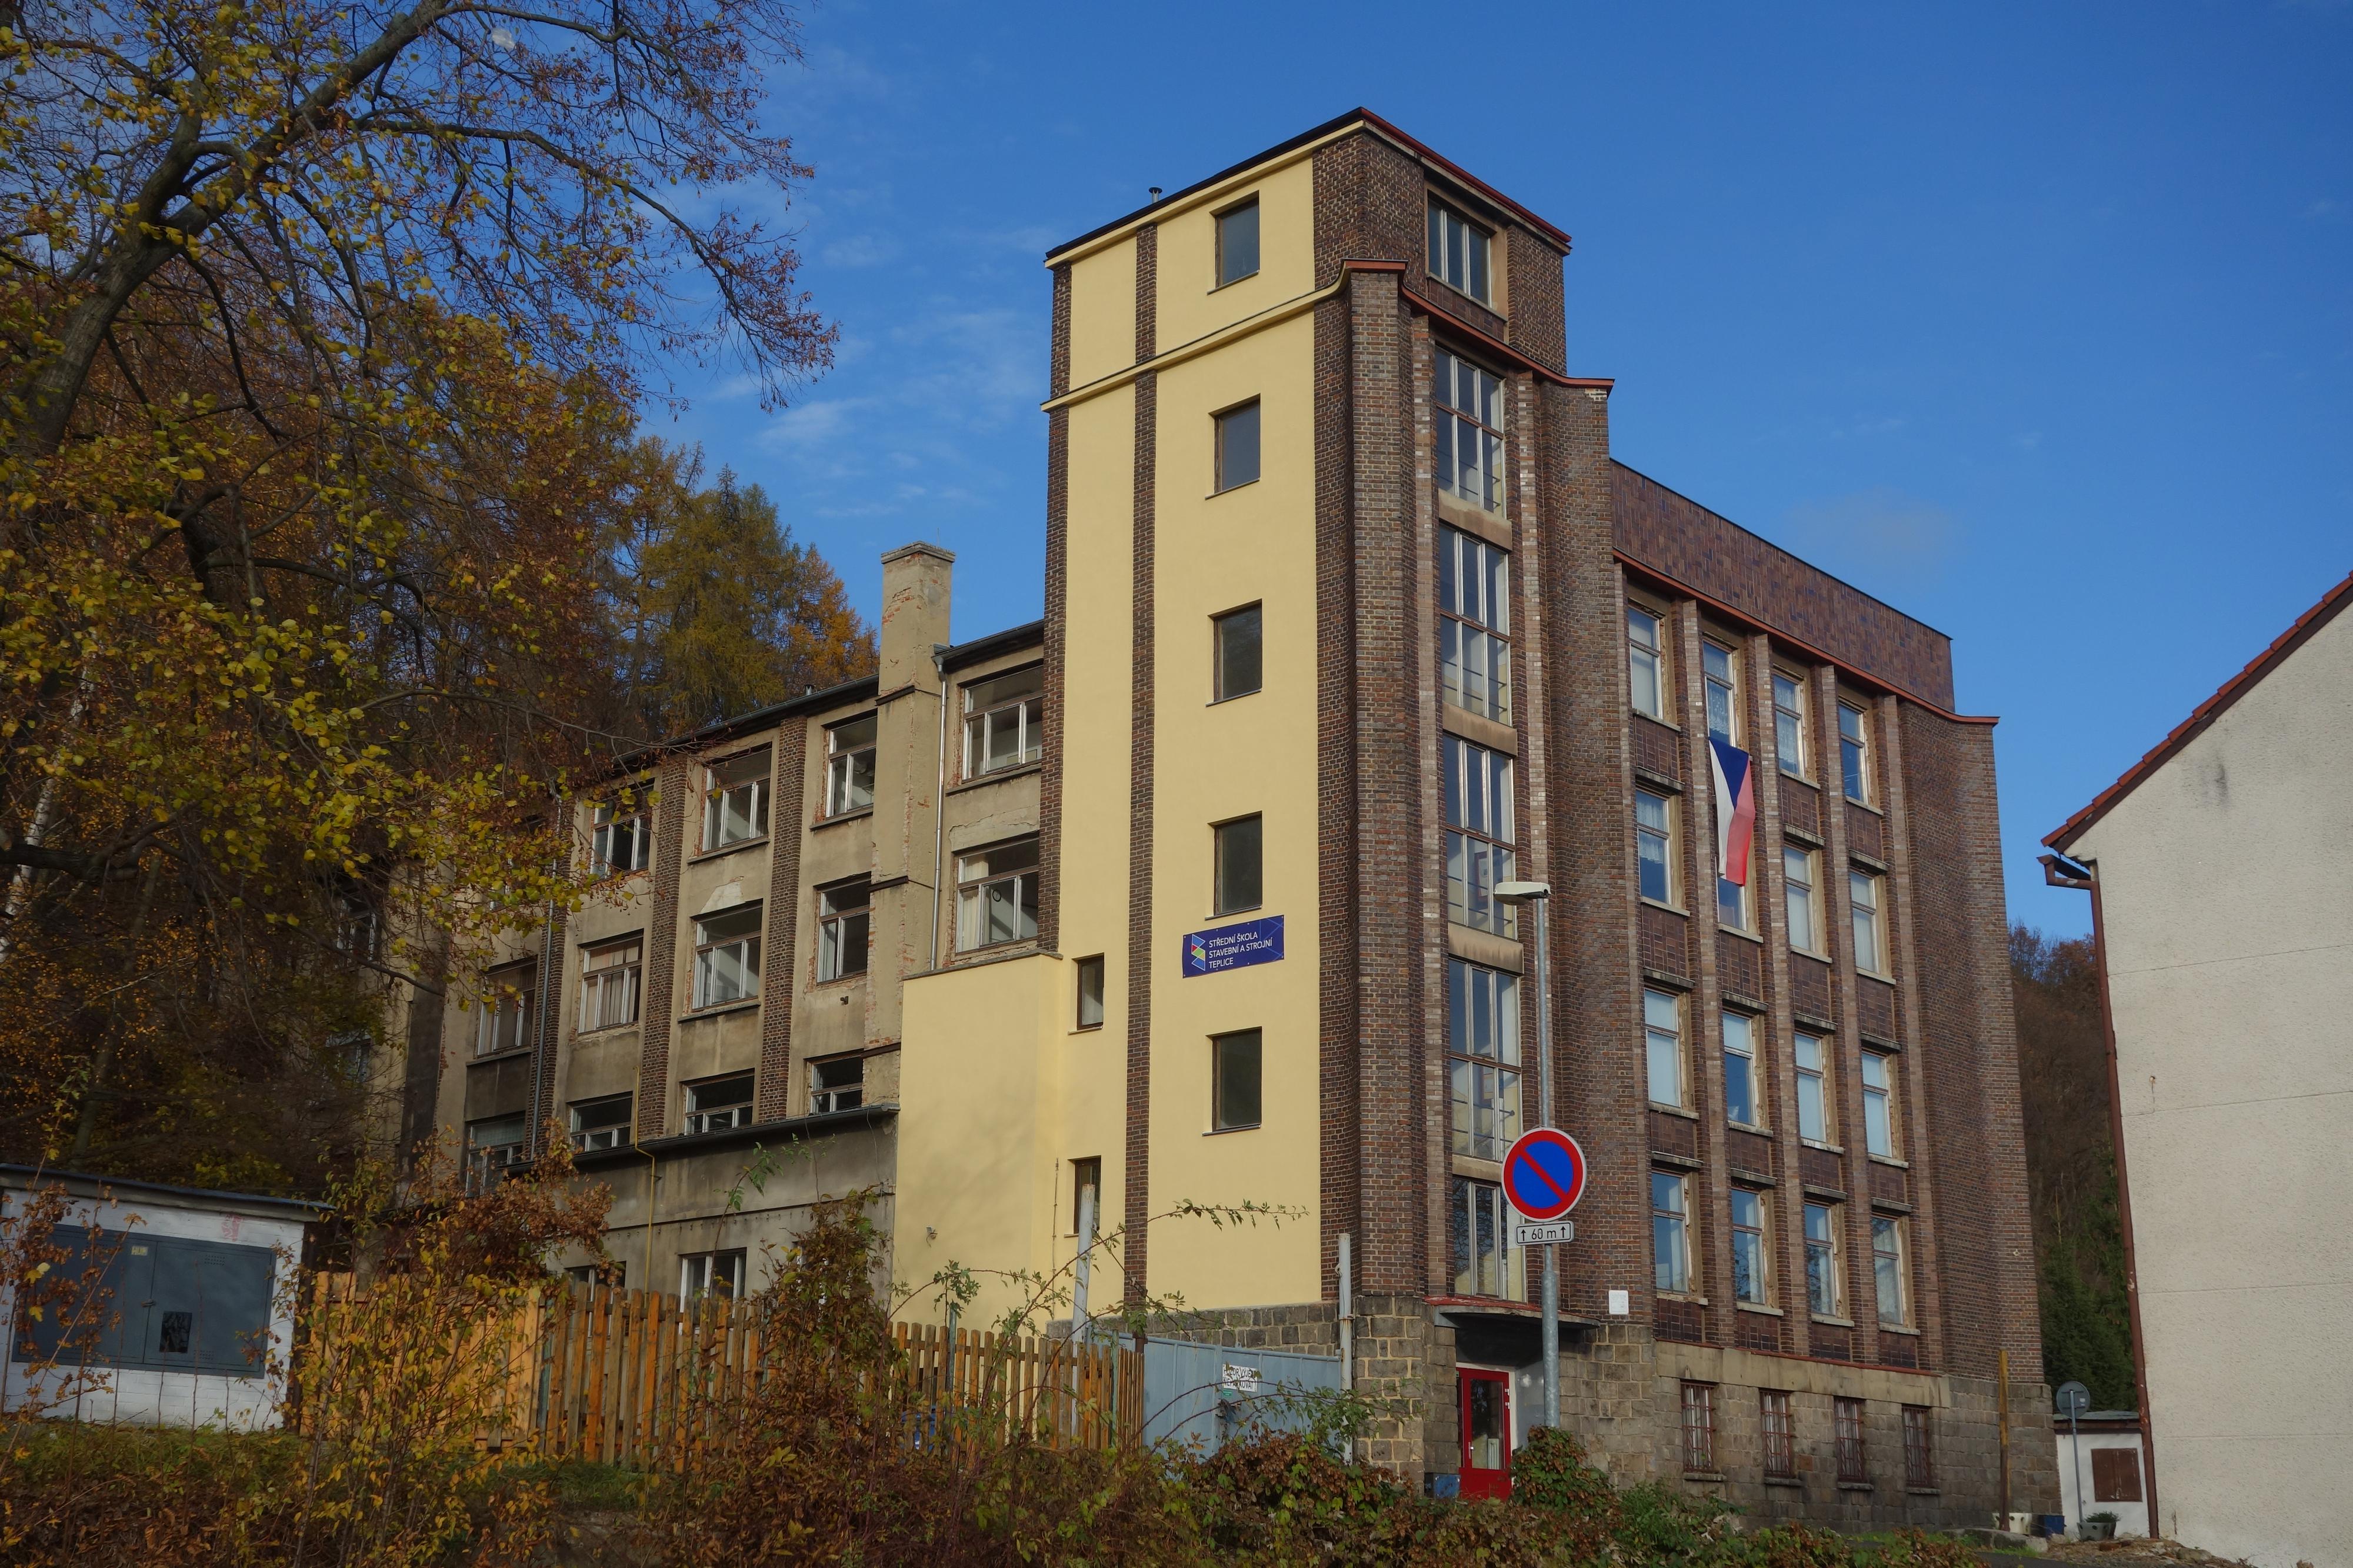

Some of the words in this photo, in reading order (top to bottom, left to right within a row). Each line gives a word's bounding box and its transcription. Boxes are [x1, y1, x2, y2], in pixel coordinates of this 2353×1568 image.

[1209, 934, 1235, 948] STŘEDNÍ
[1237, 932, 1258, 943] ŠKOLA
[1209, 945, 1239, 959] STAVEBNÍ
[1246, 937, 1272, 952] STROJNÍ
[1209, 958, 1234, 969] TEPLICE
[1531, 1227, 1543, 1240] 60
[1547, 1229, 1557, 1239] m
[1223, 1377, 1253, 1390] NEPAKOVAT
